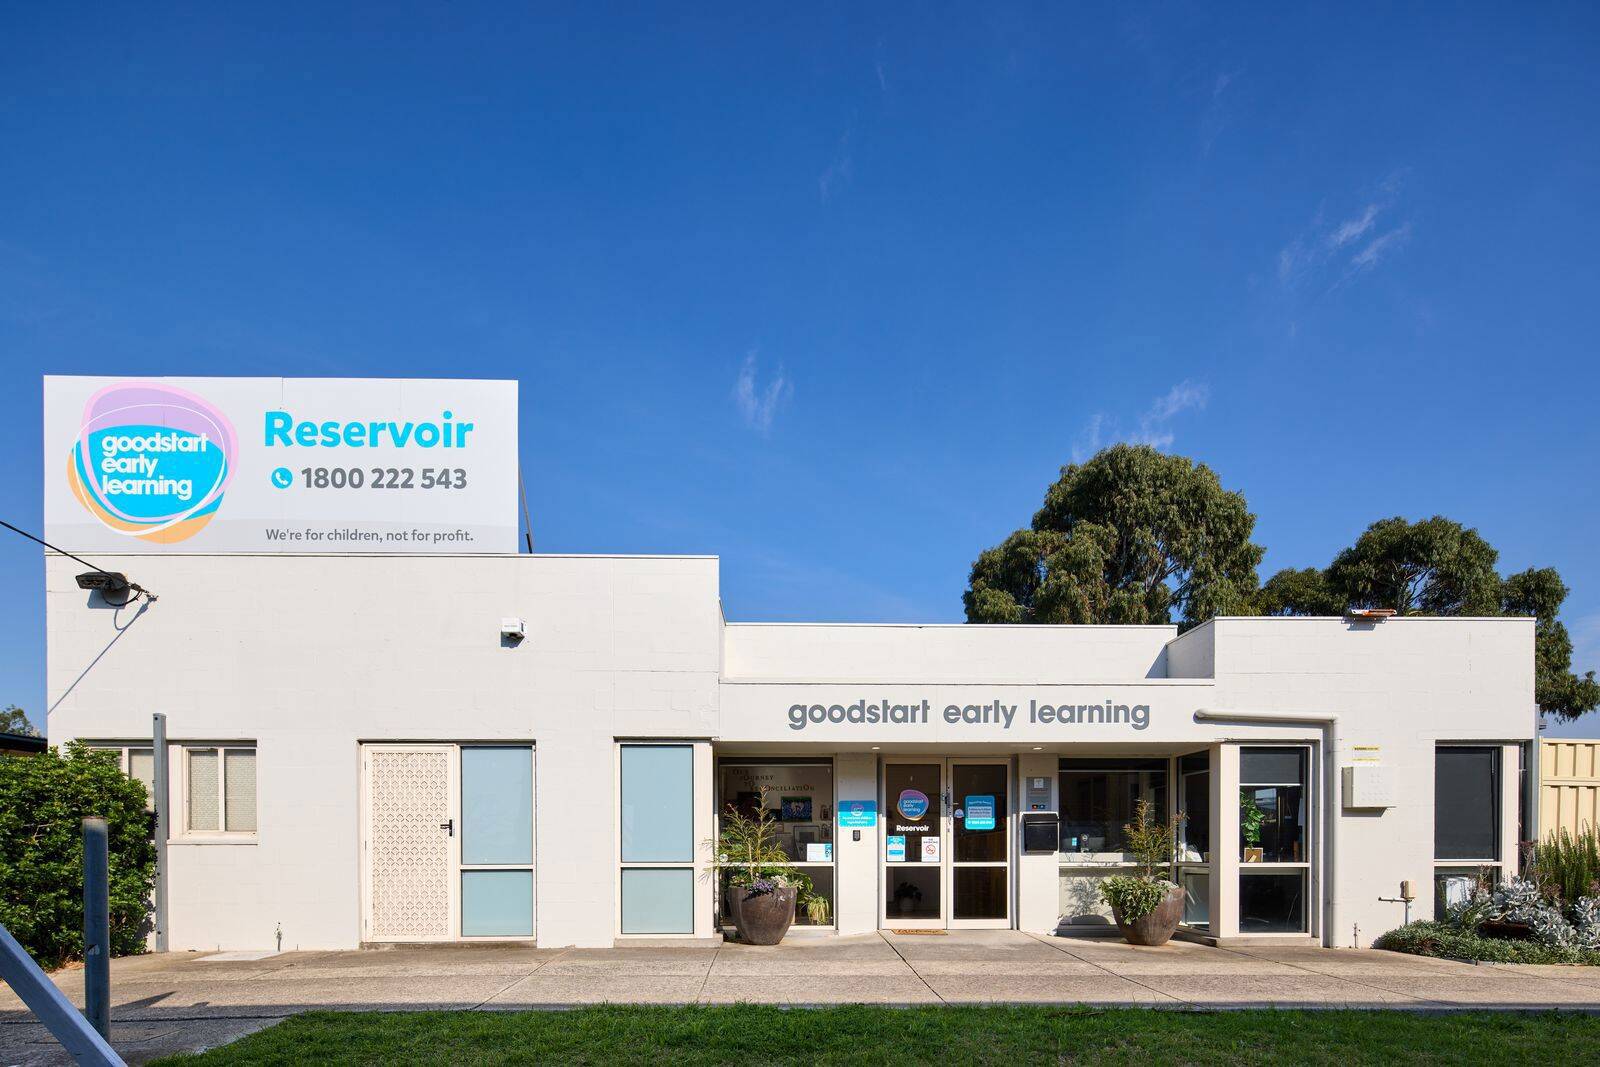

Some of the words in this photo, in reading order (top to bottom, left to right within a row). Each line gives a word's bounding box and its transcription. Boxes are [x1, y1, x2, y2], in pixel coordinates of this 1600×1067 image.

[264, 411, 474, 448] Reservoir
[101, 432, 209, 457] goodstart
[101, 453, 159, 478] early
[102, 474, 193, 501] learning
[301, 467, 365, 489] 1800
[370, 468, 414, 489] 222
[420, 468, 468, 490] 543
[265, 529, 302, 541] We're
[305, 529, 325, 541] for
[326, 529, 383, 543] children,
[386, 530, 409, 541] not
[412, 530, 431, 541] for
[433, 530, 474, 544] profit.
[788, 700, 931, 731] goodstart
[943, 700, 1018, 729] early
[1030, 700, 1151, 731] learning
